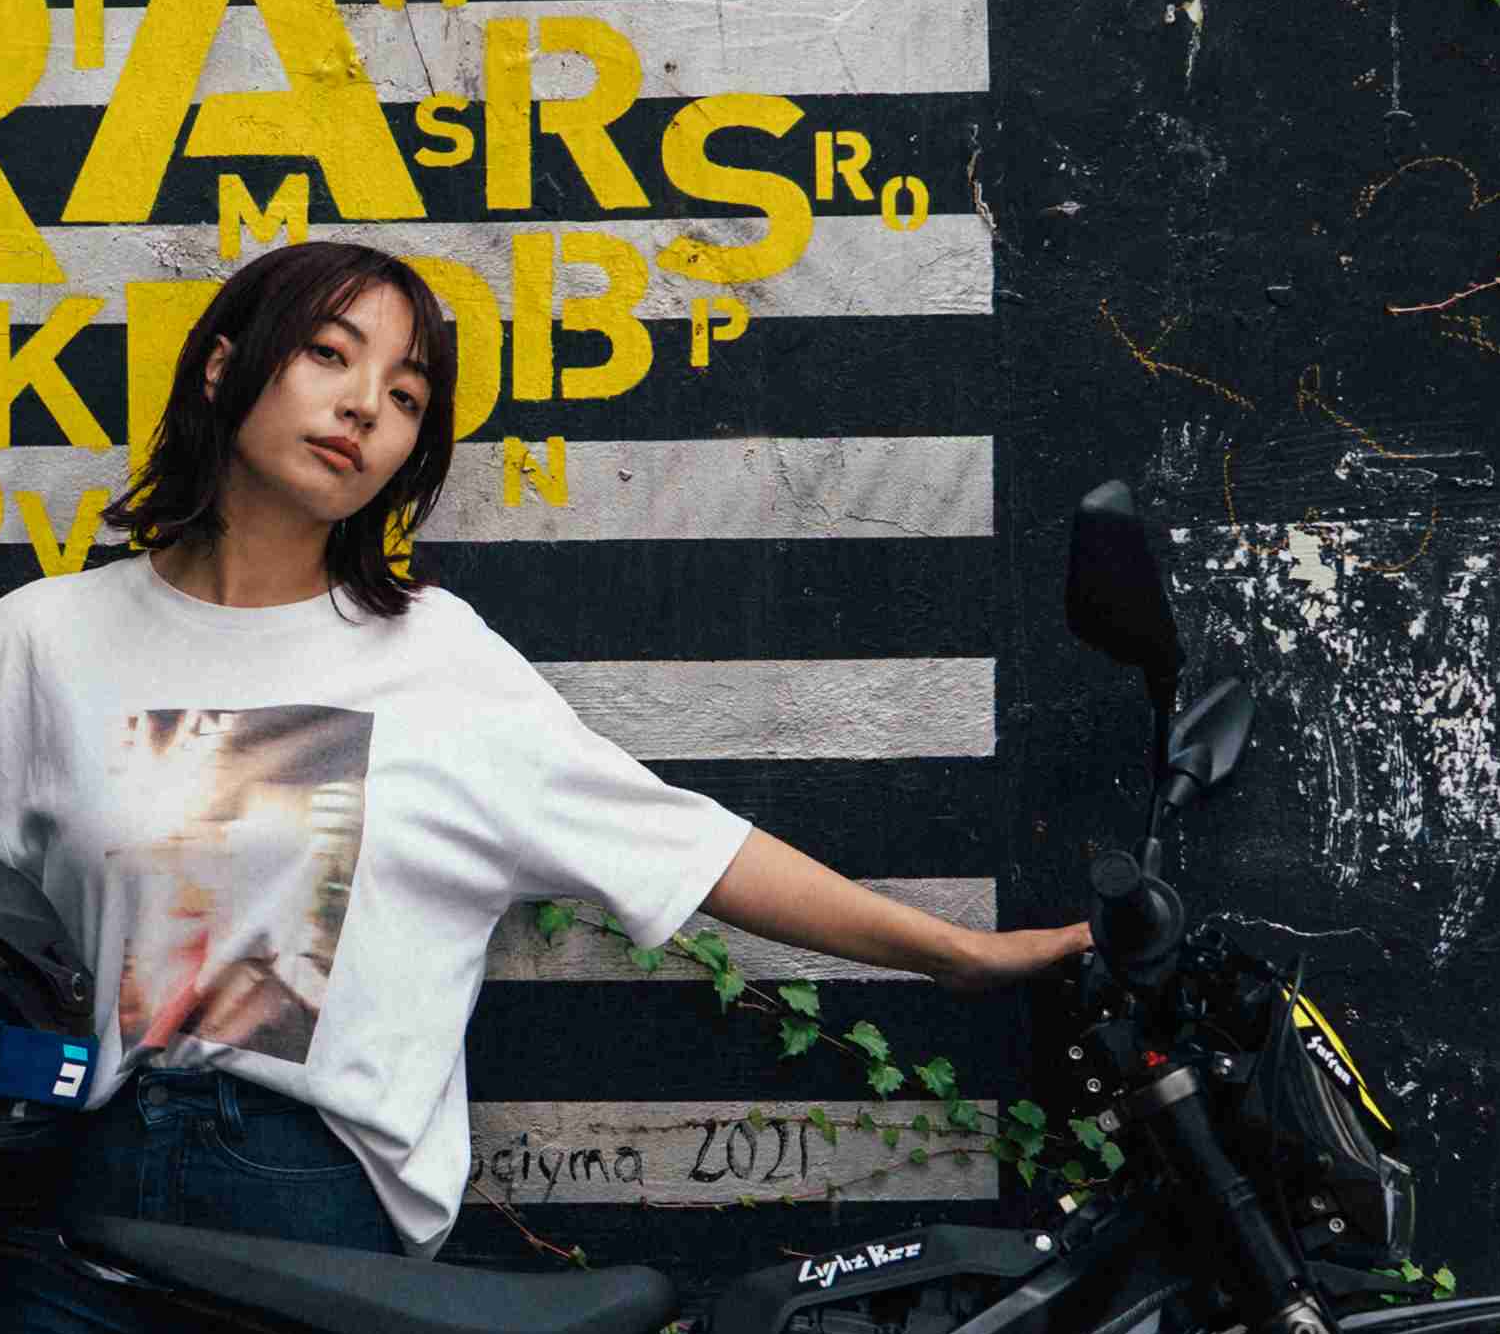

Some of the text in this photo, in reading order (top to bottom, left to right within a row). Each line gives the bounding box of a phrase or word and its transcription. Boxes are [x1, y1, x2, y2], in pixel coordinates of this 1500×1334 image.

[415, 92, 474, 167] S
[484, 17, 650, 210] R
[657, 92, 813, 285] S
[815, 131, 874, 201] R
[881, 176, 930, 231] O
[512, 232, 653, 401] B
[690, 297, 750, 367] P
[504, 436, 568, 507] N
[688, 1117, 808, 1183] 2021
